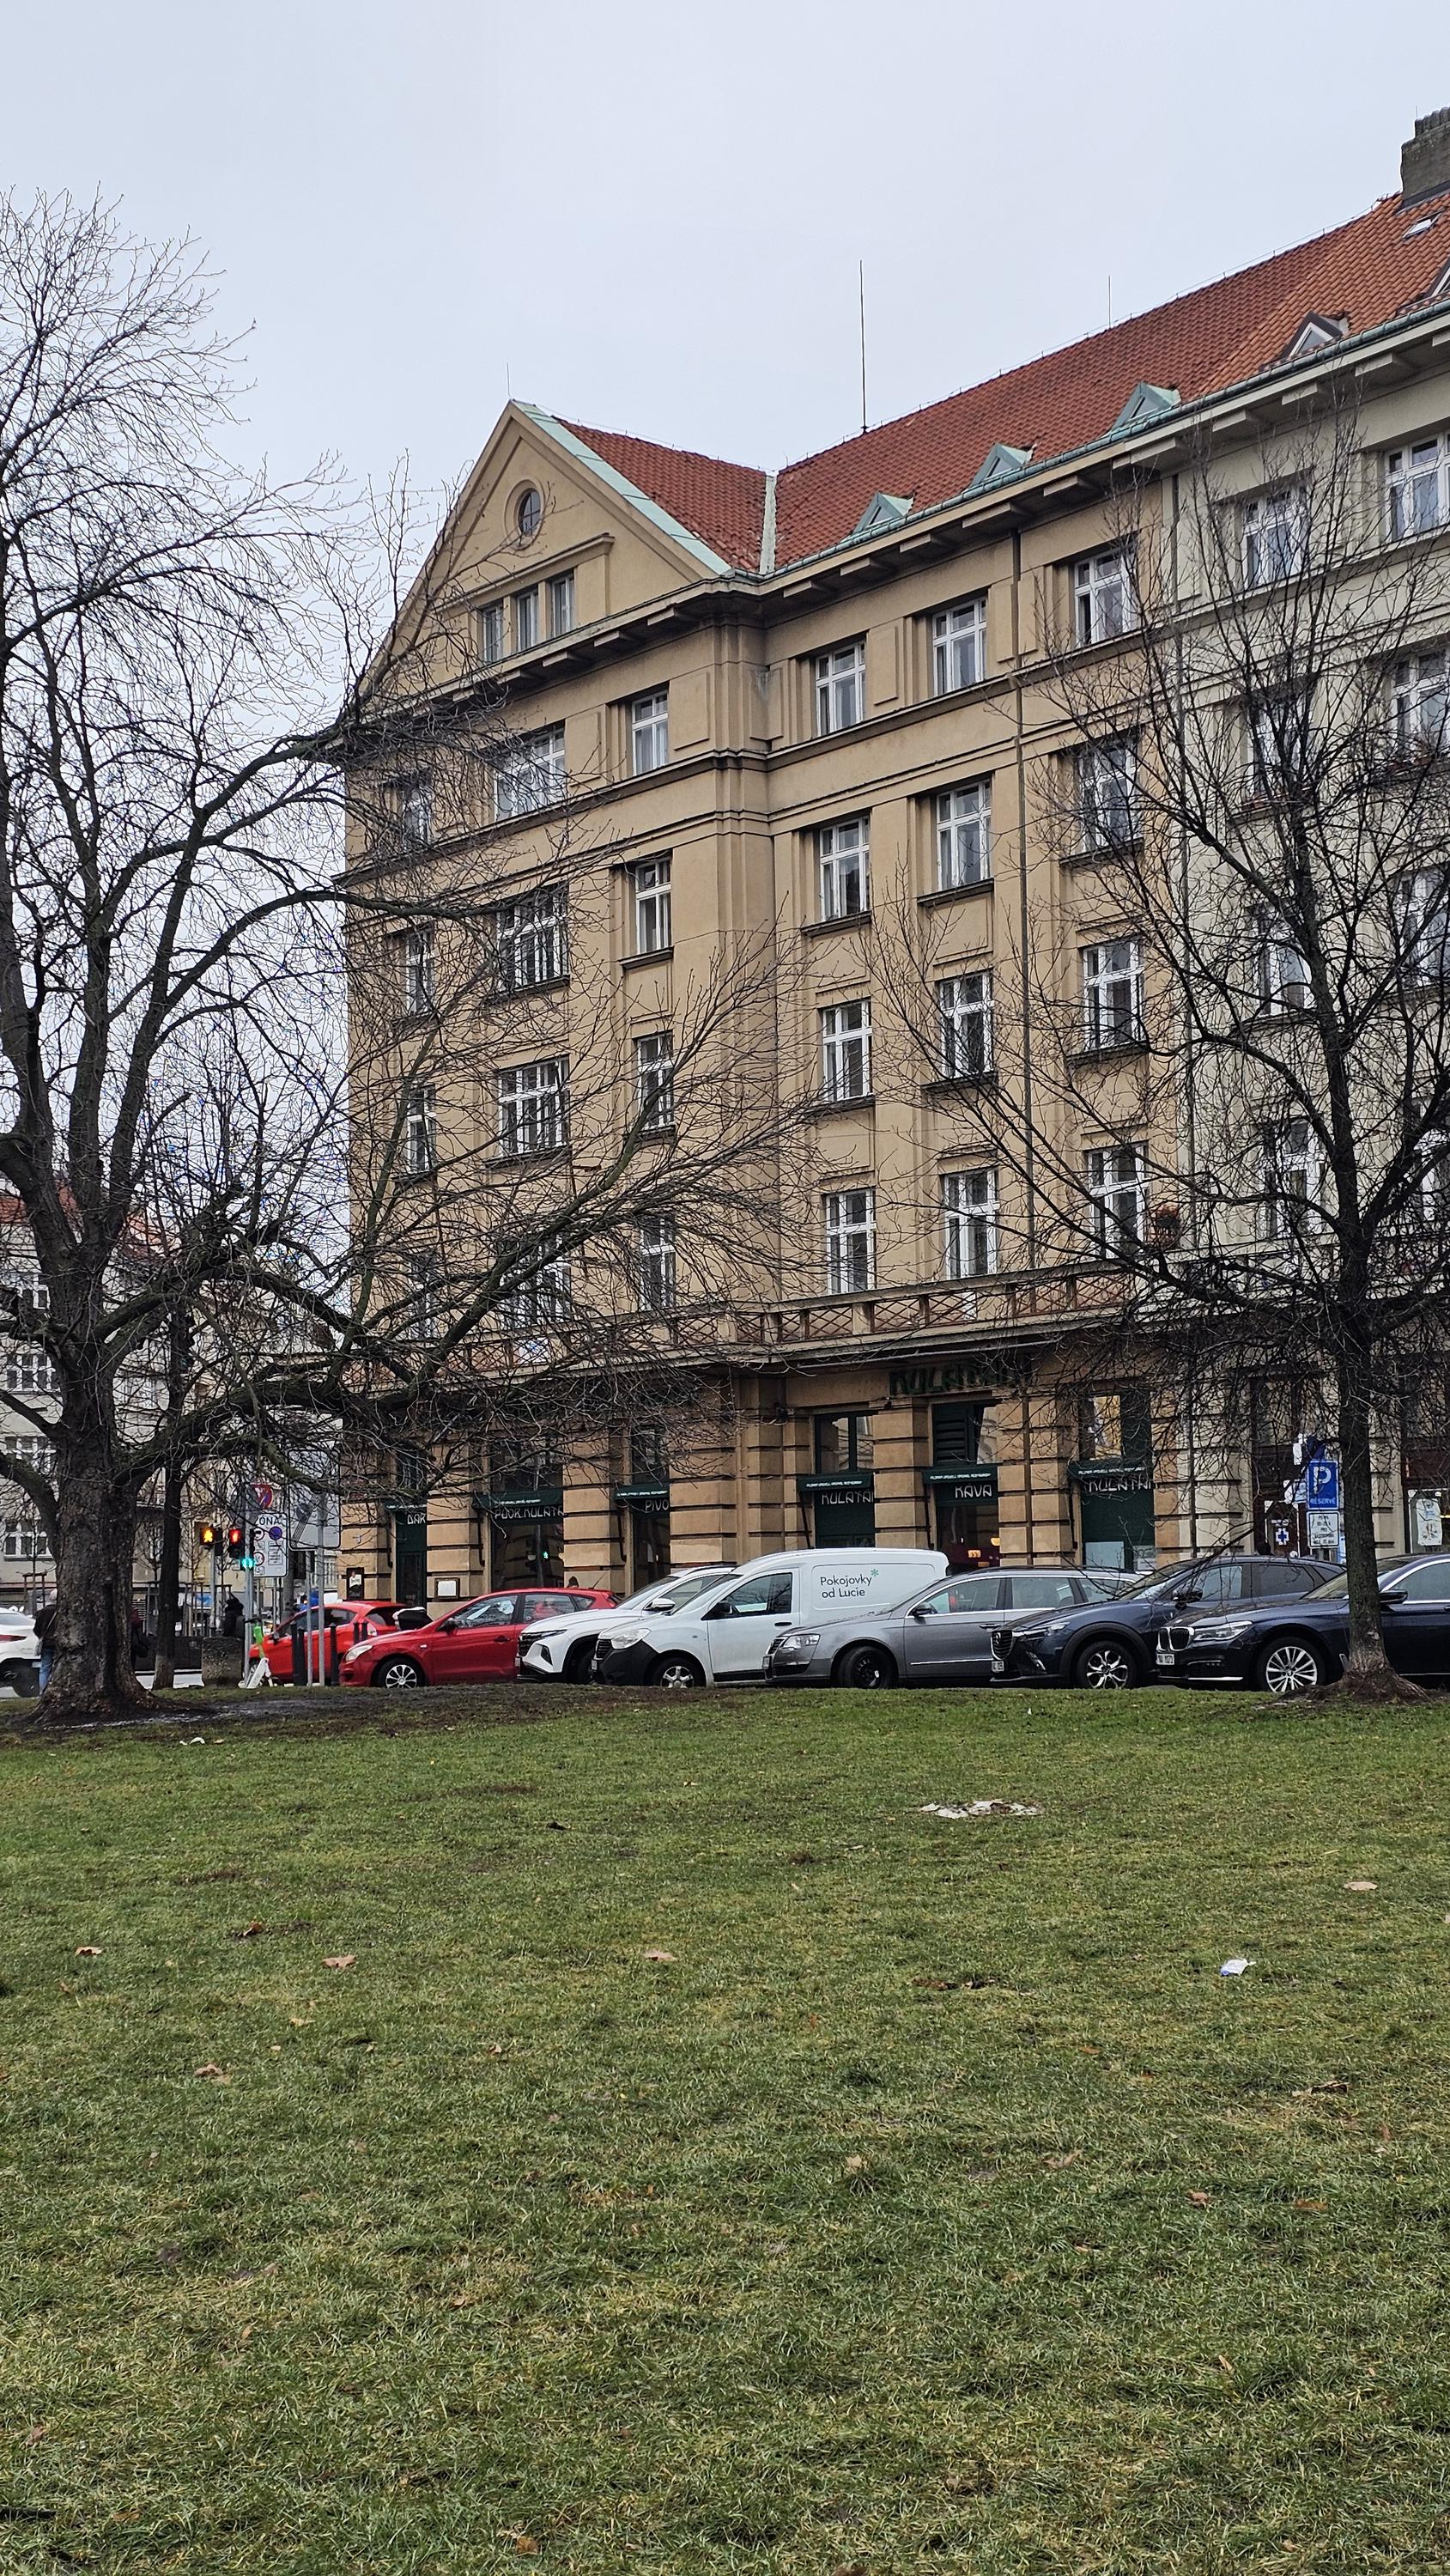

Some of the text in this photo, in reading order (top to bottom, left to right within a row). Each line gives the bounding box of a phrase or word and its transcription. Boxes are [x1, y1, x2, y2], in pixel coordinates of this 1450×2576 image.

[1313, 1466, 1332, 1494] P
[645, 1499, 669, 1512] PIVO
[820, 1574, 872, 1588] Pokojovky
[822, 1588, 865, 1598] od Lucie
